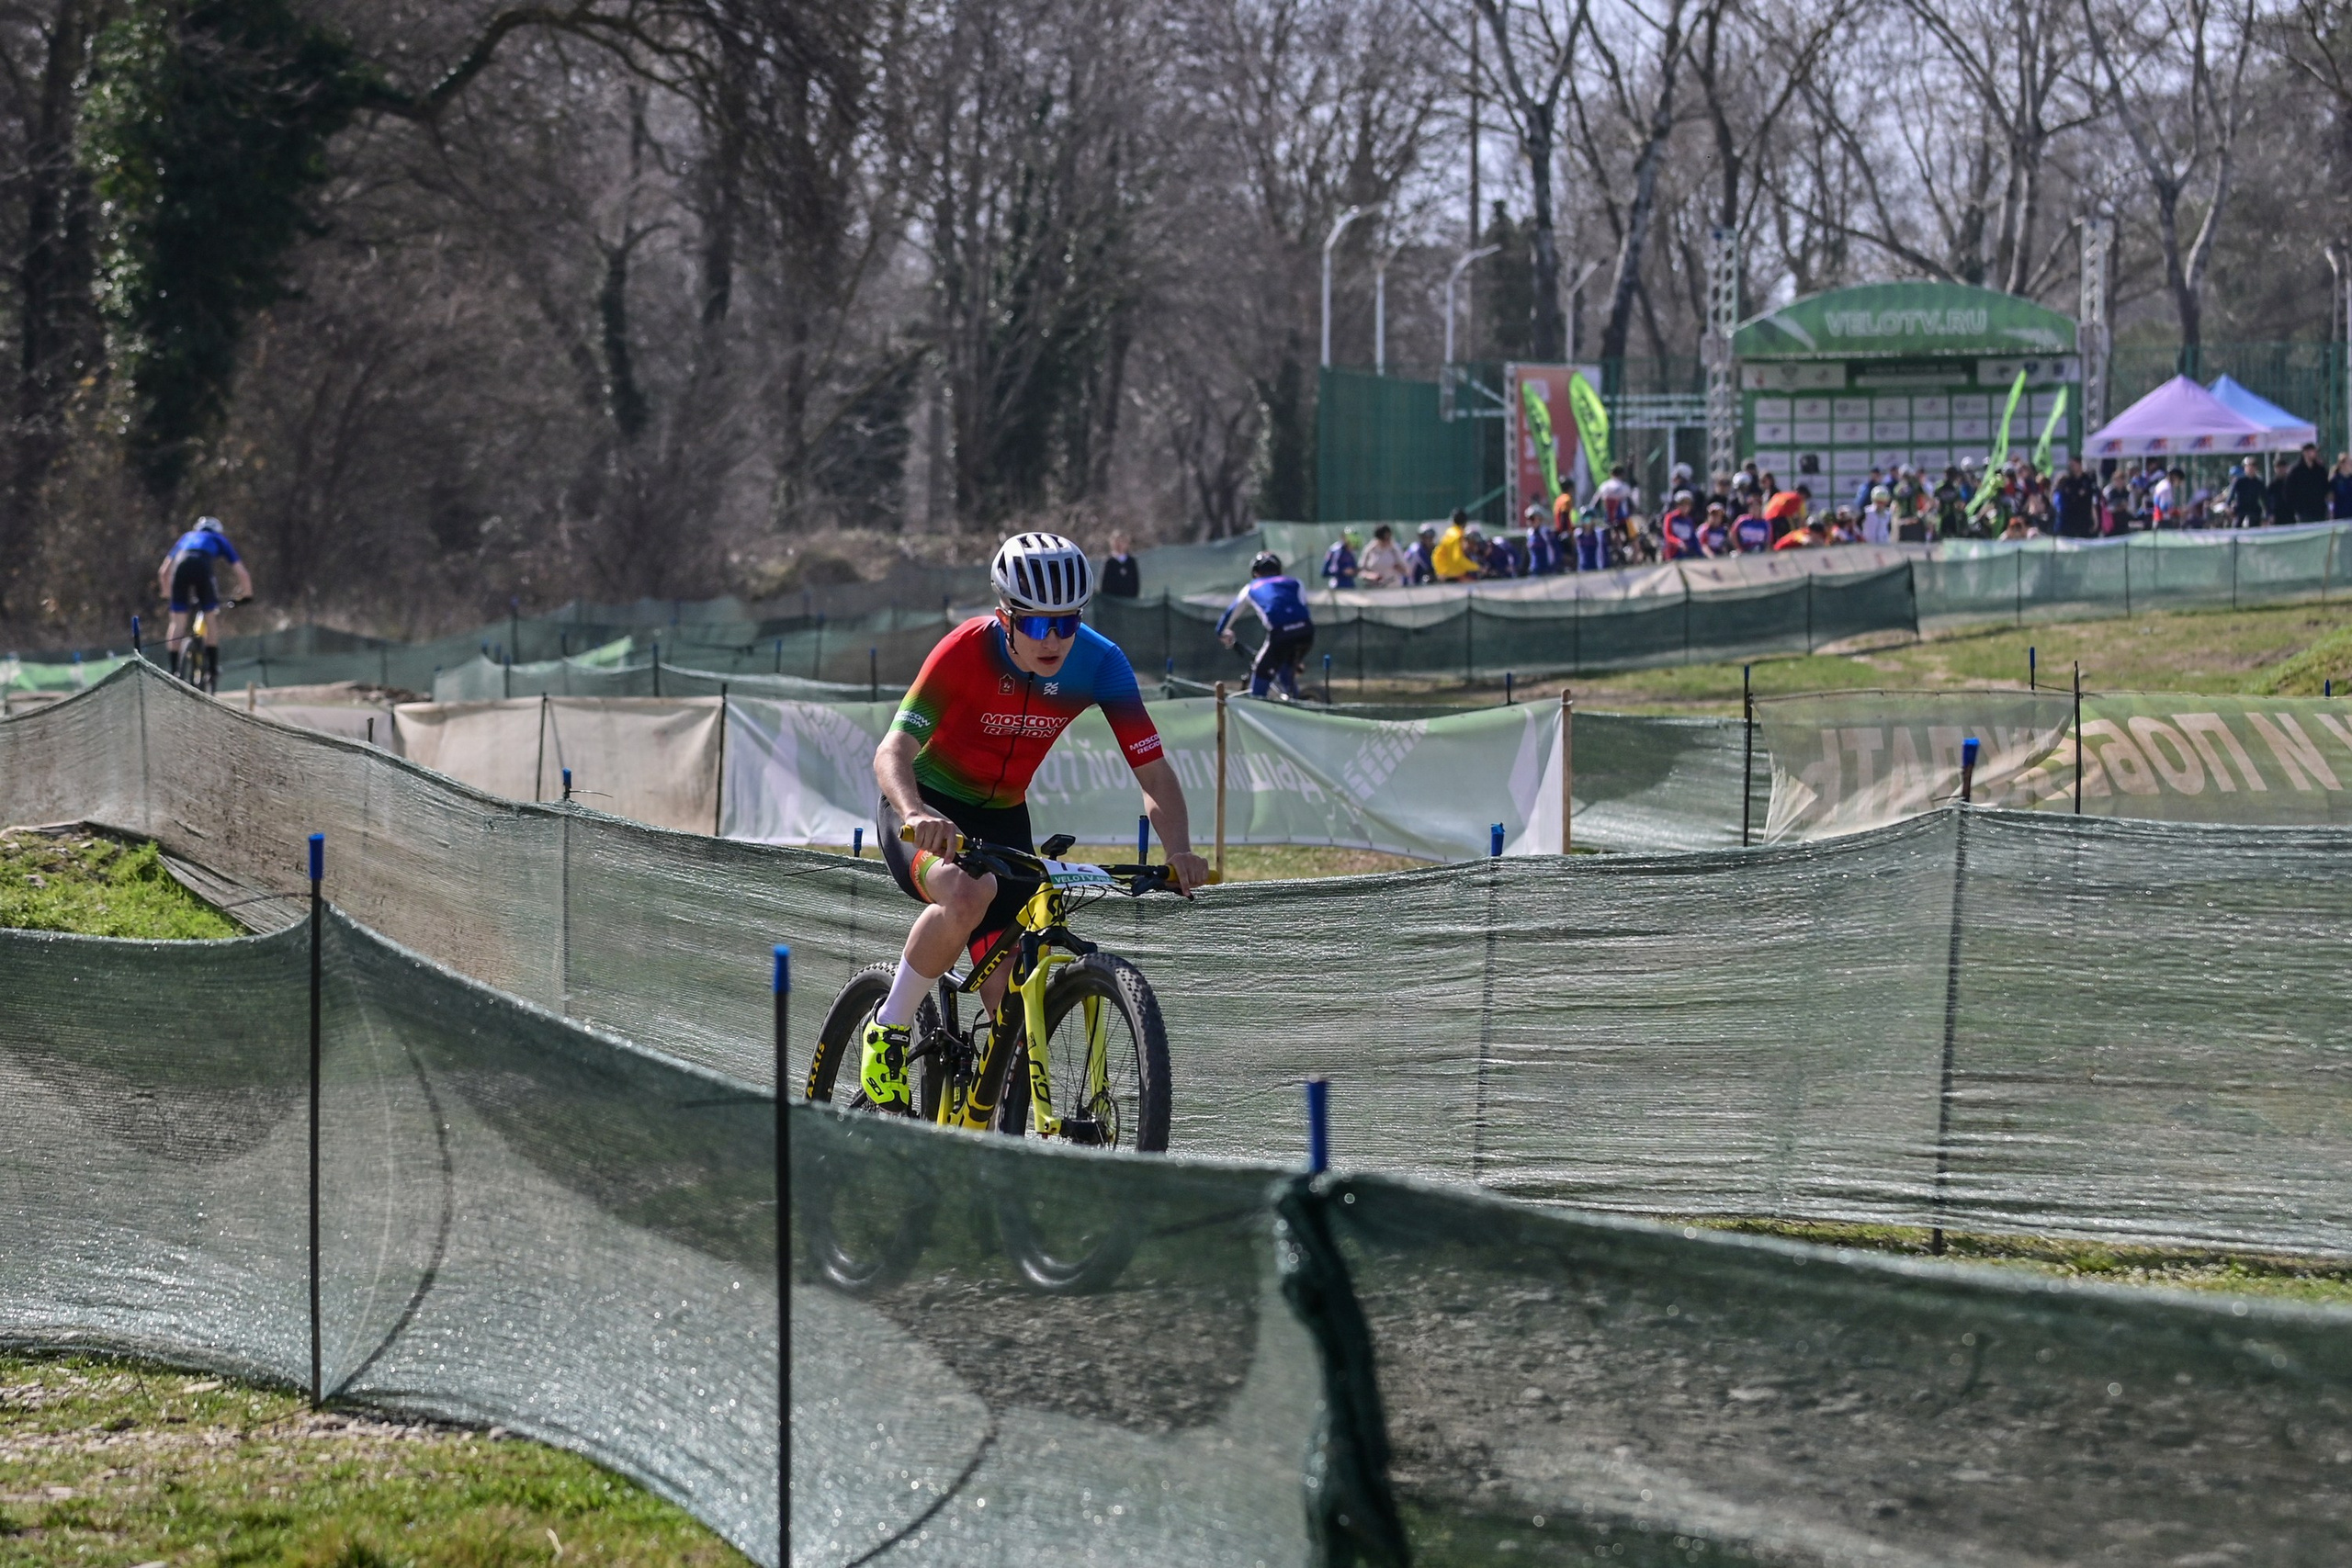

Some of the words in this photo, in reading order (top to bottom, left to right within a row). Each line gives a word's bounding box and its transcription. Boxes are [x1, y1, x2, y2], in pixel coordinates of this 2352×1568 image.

[1824, 308, 1987, 337] VELOTV.RU
[896, 710, 931, 727] SCOW
[980, 713, 1068, 729] MOSCOW
[983, 725, 1056, 739] REGION
[1129, 734, 1159, 750] MOSCO
[1137, 740, 1160, 755] REGIO
[807, 1042, 825, 1099] AXXIS
